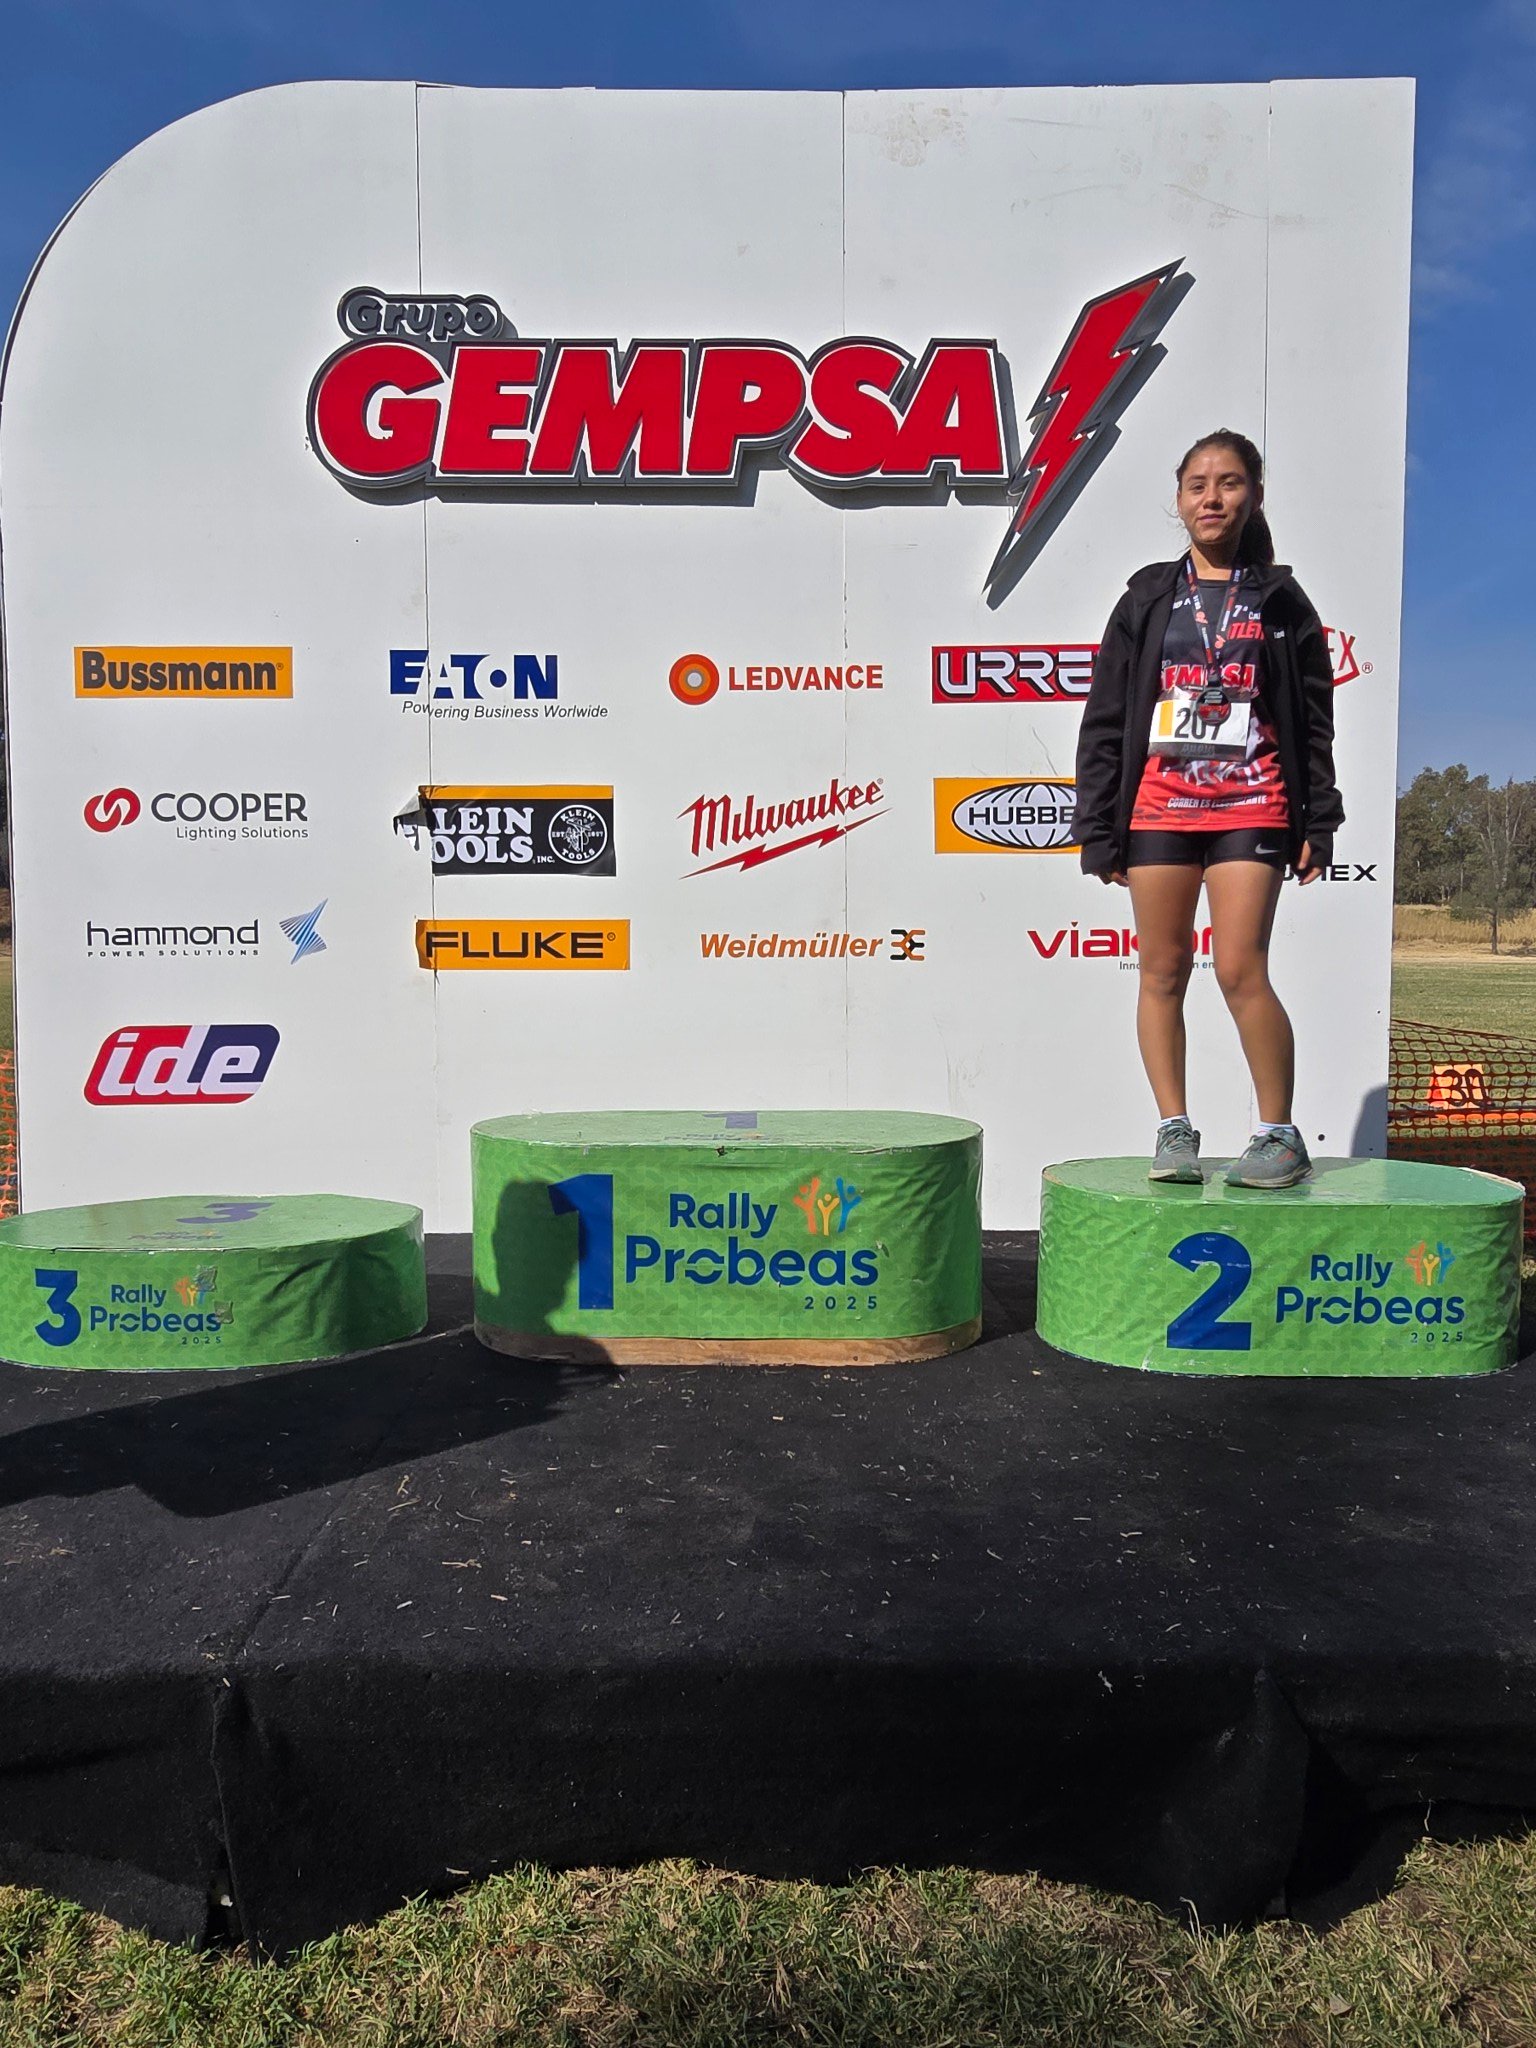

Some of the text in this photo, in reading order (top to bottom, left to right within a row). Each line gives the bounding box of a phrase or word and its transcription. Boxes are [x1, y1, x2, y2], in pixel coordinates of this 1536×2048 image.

[348, 295, 497, 341] Grupo
[314, 342, 1006, 484] GEMPSA
[82, 650, 277, 692] Bussmann
[389, 649, 558, 700] EATON
[728, 664, 884, 691] LEDVANCE
[938, 650, 1095, 697] URRE
[402, 701, 609, 721] Powering Business Worlwide
[151, 792, 308, 822] COOPER
[432, 807, 535, 835] LEIN
[560, 809, 595, 822] KLEIN
[676, 778, 885, 858] Milwaukee
[968, 806, 1075, 826] HUBBE
[176, 826, 309, 841] Lighting Solutions
[432, 835, 534, 863] OOLS
[561, 847, 596, 860] TOOLS
[87, 919, 259, 946] hammond
[425, 931, 604, 959] FLUKE
[700, 932, 884, 958] Weidmüller
[158, 949, 259, 957] SOLUTIONS
[97, 1024, 266, 1097] ide
[669, 1192, 779, 1239] Rally
[548, 1173, 614, 1310] 1
[625, 1235, 879, 1287] Probeas
[1310, 1253, 1393, 1288] Rally
[110, 1283, 167, 1308] Rally
[804, 1295, 878, 1311] 2025
[1166, 1231, 1253, 1351] 2
[34, 1268, 82, 1347] 3
[89, 1304, 222, 1333] Probeas
[1275, 1286, 1466, 1326] Probeas
[181, 1336, 222, 1345] 2025
[1410, 1331, 1464, 1344] 2025
